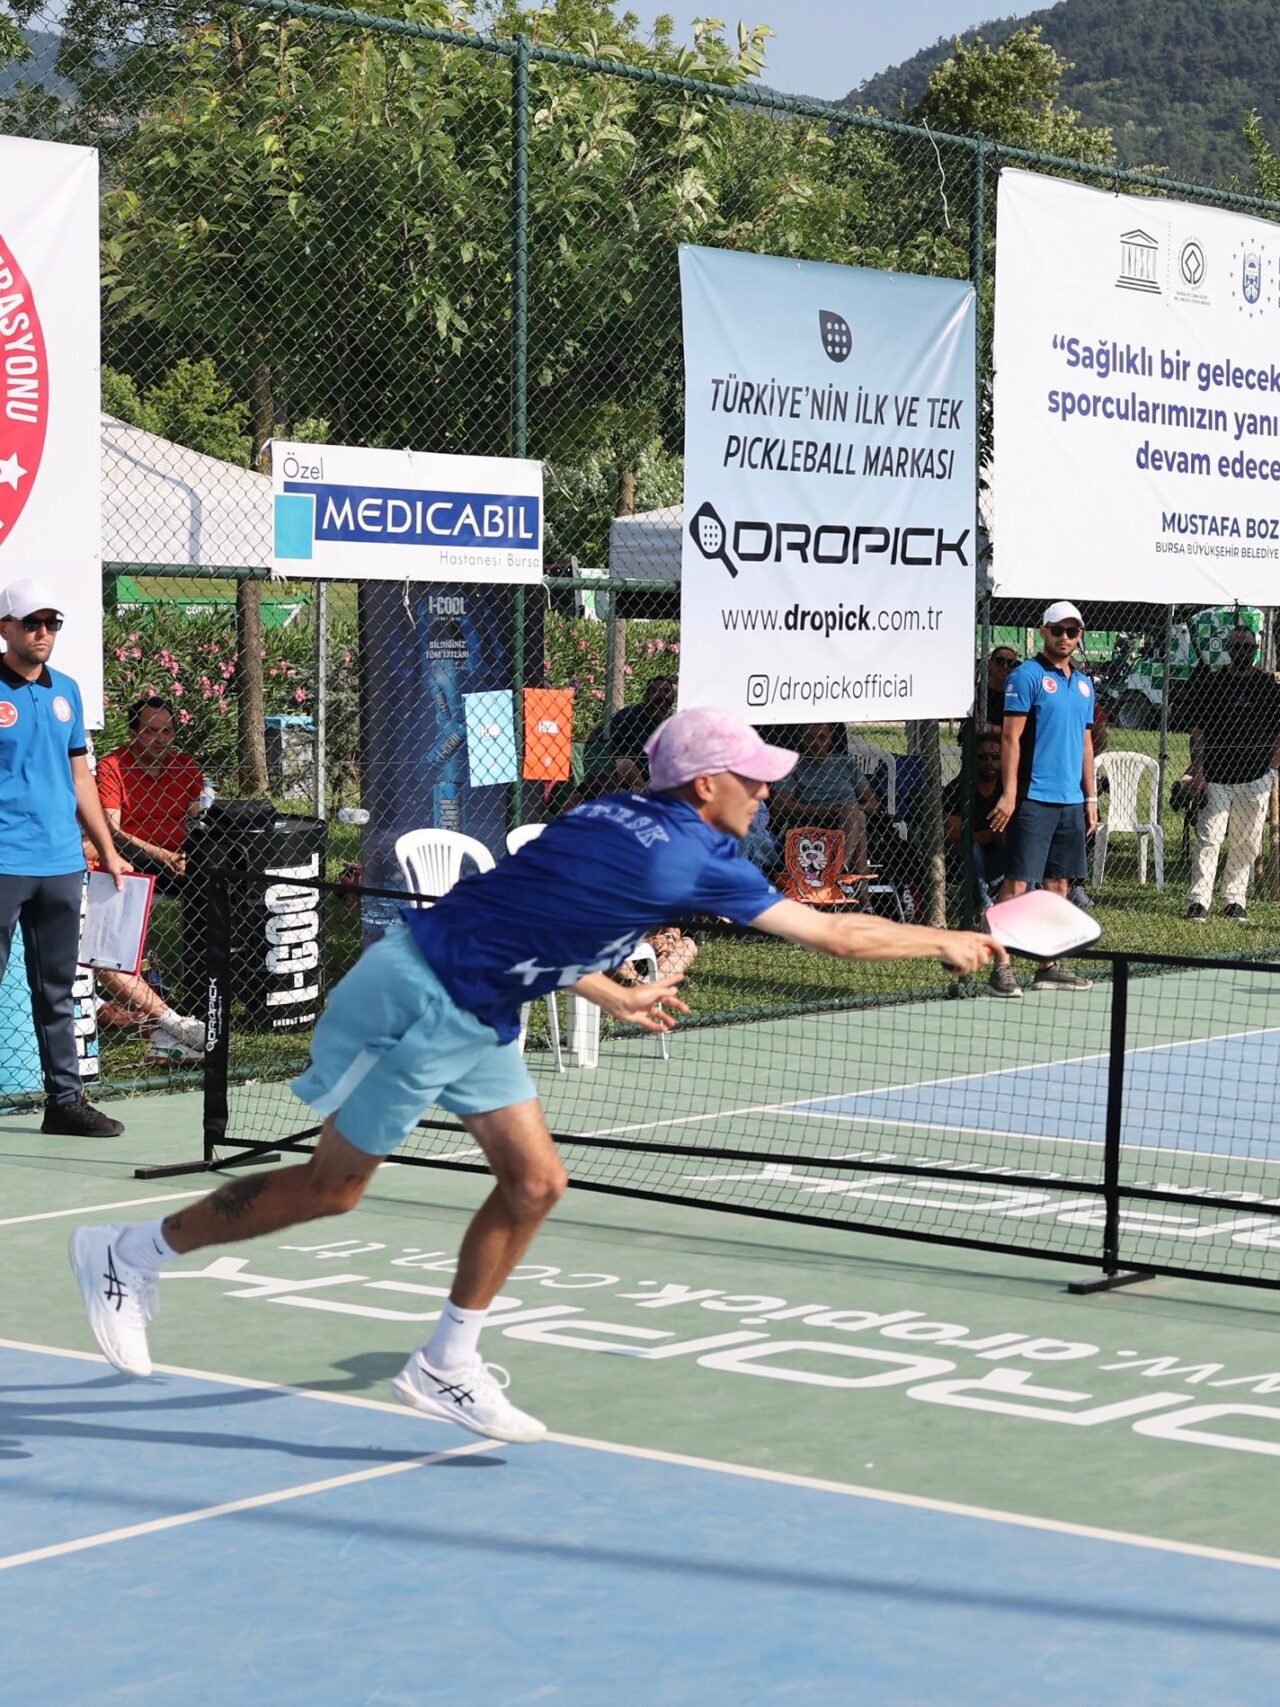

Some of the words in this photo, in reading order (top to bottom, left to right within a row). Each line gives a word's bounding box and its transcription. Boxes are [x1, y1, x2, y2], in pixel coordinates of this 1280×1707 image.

[1160, 349, 1191, 381] bir
[855, 386, 889, 426] İLK
[894, 395, 918, 427] VE
[927, 397, 964, 430] TEK
[1047, 388, 1228, 432] sporcularımızın
[283, 452, 324, 480] Özel
[723, 434, 857, 475] PICKLEBALL
[863, 444, 955, 479] MARKASI
[1135, 440, 1211, 476] devam
[322, 496, 533, 539] MEDICABIL
[1161, 511, 1241, 538] MUSTAFA
[439, 551, 502, 567] Hastanesi
[507, 553, 540, 568] Bursa
[733, 521, 971, 566] DROPICK
[1156, 541, 1185, 554] BURSA
[1187, 542, 1239, 559] BÜYÜKŞEHİR
[1241, 544, 1279, 559] BELEDİYE
[428, 596, 467, 615] I-COOL
[721, 603, 943, 638] www.dropick.com.tr
[265, 853, 319, 1006] I-COOL
